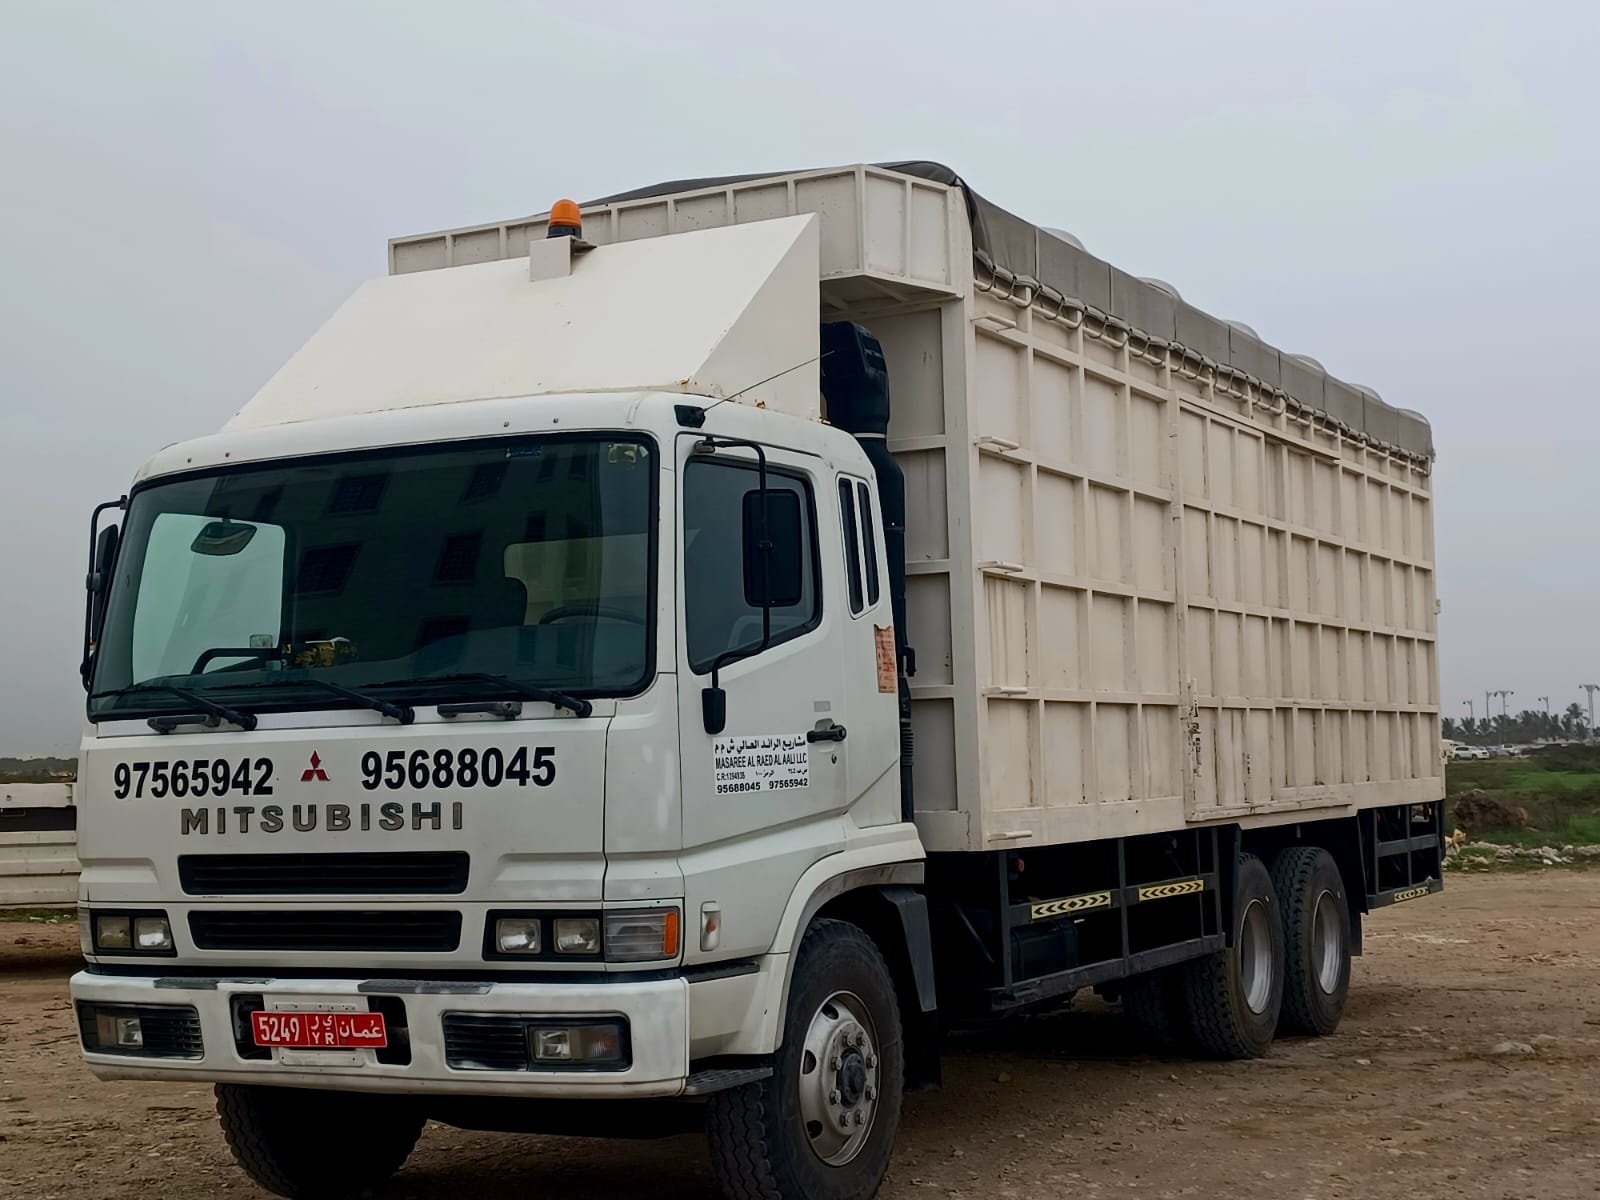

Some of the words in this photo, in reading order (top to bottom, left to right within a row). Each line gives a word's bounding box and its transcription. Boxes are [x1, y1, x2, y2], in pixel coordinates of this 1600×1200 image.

[714, 743, 720, 754] م
[720, 743, 725, 754] م
[726, 738, 735, 754] ش
[737, 739, 760, 754] العالي
[361, 747, 556, 790] 95688045
[715, 755, 747, 770] MASAREE
[747, 755, 756, 768] AL
[756, 754, 773, 767] RAED
[774, 753, 782, 766] AL
[114, 757, 273, 799] 97565942
[768, 777, 808, 790] 97565942
[716, 781, 761, 794] 95688045
[181, 802, 462, 835] MITSUBISHI
[258, 1016, 299, 1042] 5249
[312, 1032, 320, 1044] Y
[325, 1032, 335, 1045] R
